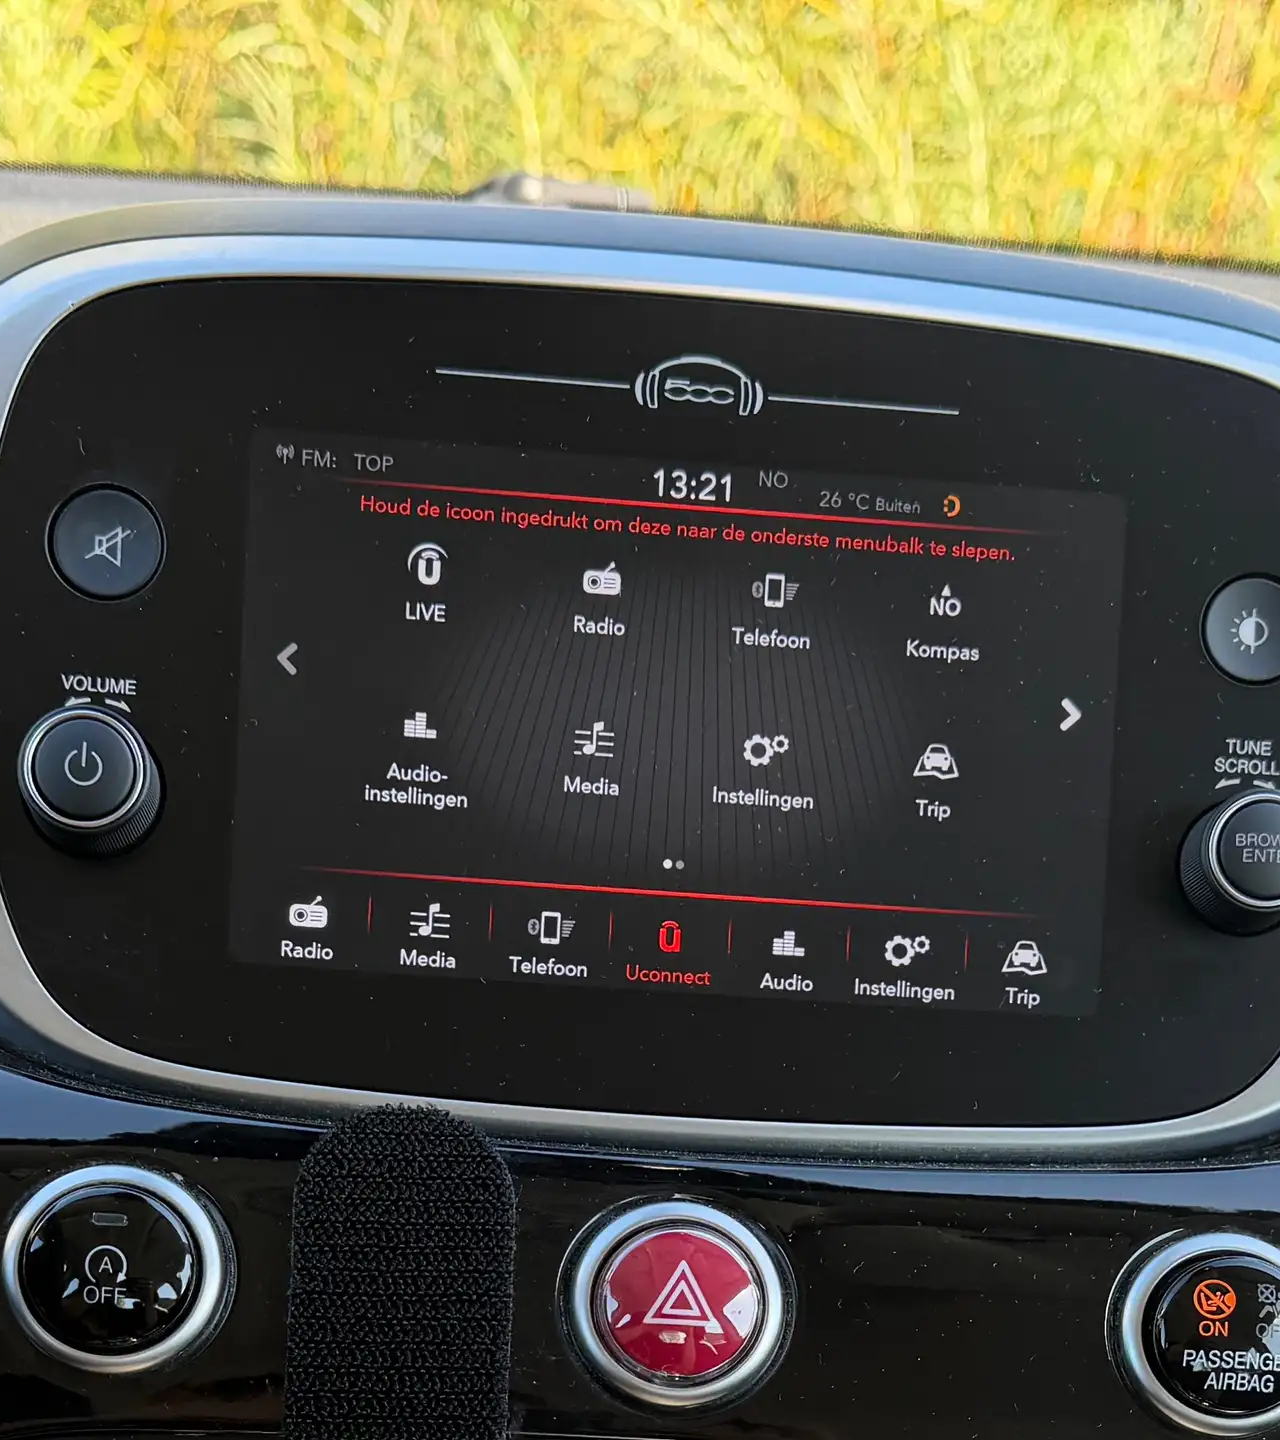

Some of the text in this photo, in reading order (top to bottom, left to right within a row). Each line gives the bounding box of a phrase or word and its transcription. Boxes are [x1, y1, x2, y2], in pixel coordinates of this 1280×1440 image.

[301, 449, 394, 472] FM: TOP
[653, 468, 732, 502] 13:21
[758, 470, 789, 489] NO
[819, 491, 920, 514] 26 °C Buiten
[360, 495, 1016, 563] Houd de icoon ingedrukt om deze naar de onderste menubalk te slepen.
[405, 601, 447, 623] LIVE
[929, 597, 962, 617] NO
[574, 615, 626, 637] Radio
[732, 627, 811, 650] Telefoon
[906, 639, 981, 664] Kompas
[61, 673, 138, 696] VOLUME
[1225, 738, 1273, 757] TUNE
[386, 762, 449, 784] Audio-
[563, 775, 620, 797] Media
[364, 785, 469, 811] instellingen
[712, 786, 814, 812] Instellingen
[915, 799, 951, 822] Trip
[280, 940, 334, 961] Radio
[400, 948, 456, 969] Media
[509, 956, 588, 978] Telefoon
[626, 964, 712, 986] Uconnect
[760, 972, 814, 993] Audio
[854, 978, 956, 1002] Instellingen
[1005, 987, 1042, 1009] Trip
[98, 1255, 114, 1274] A
[83, 1285, 127, 1306] OFF
[1198, 1320, 1229, 1338] ON
[1204, 1371, 1275, 1394] AIRBAG
